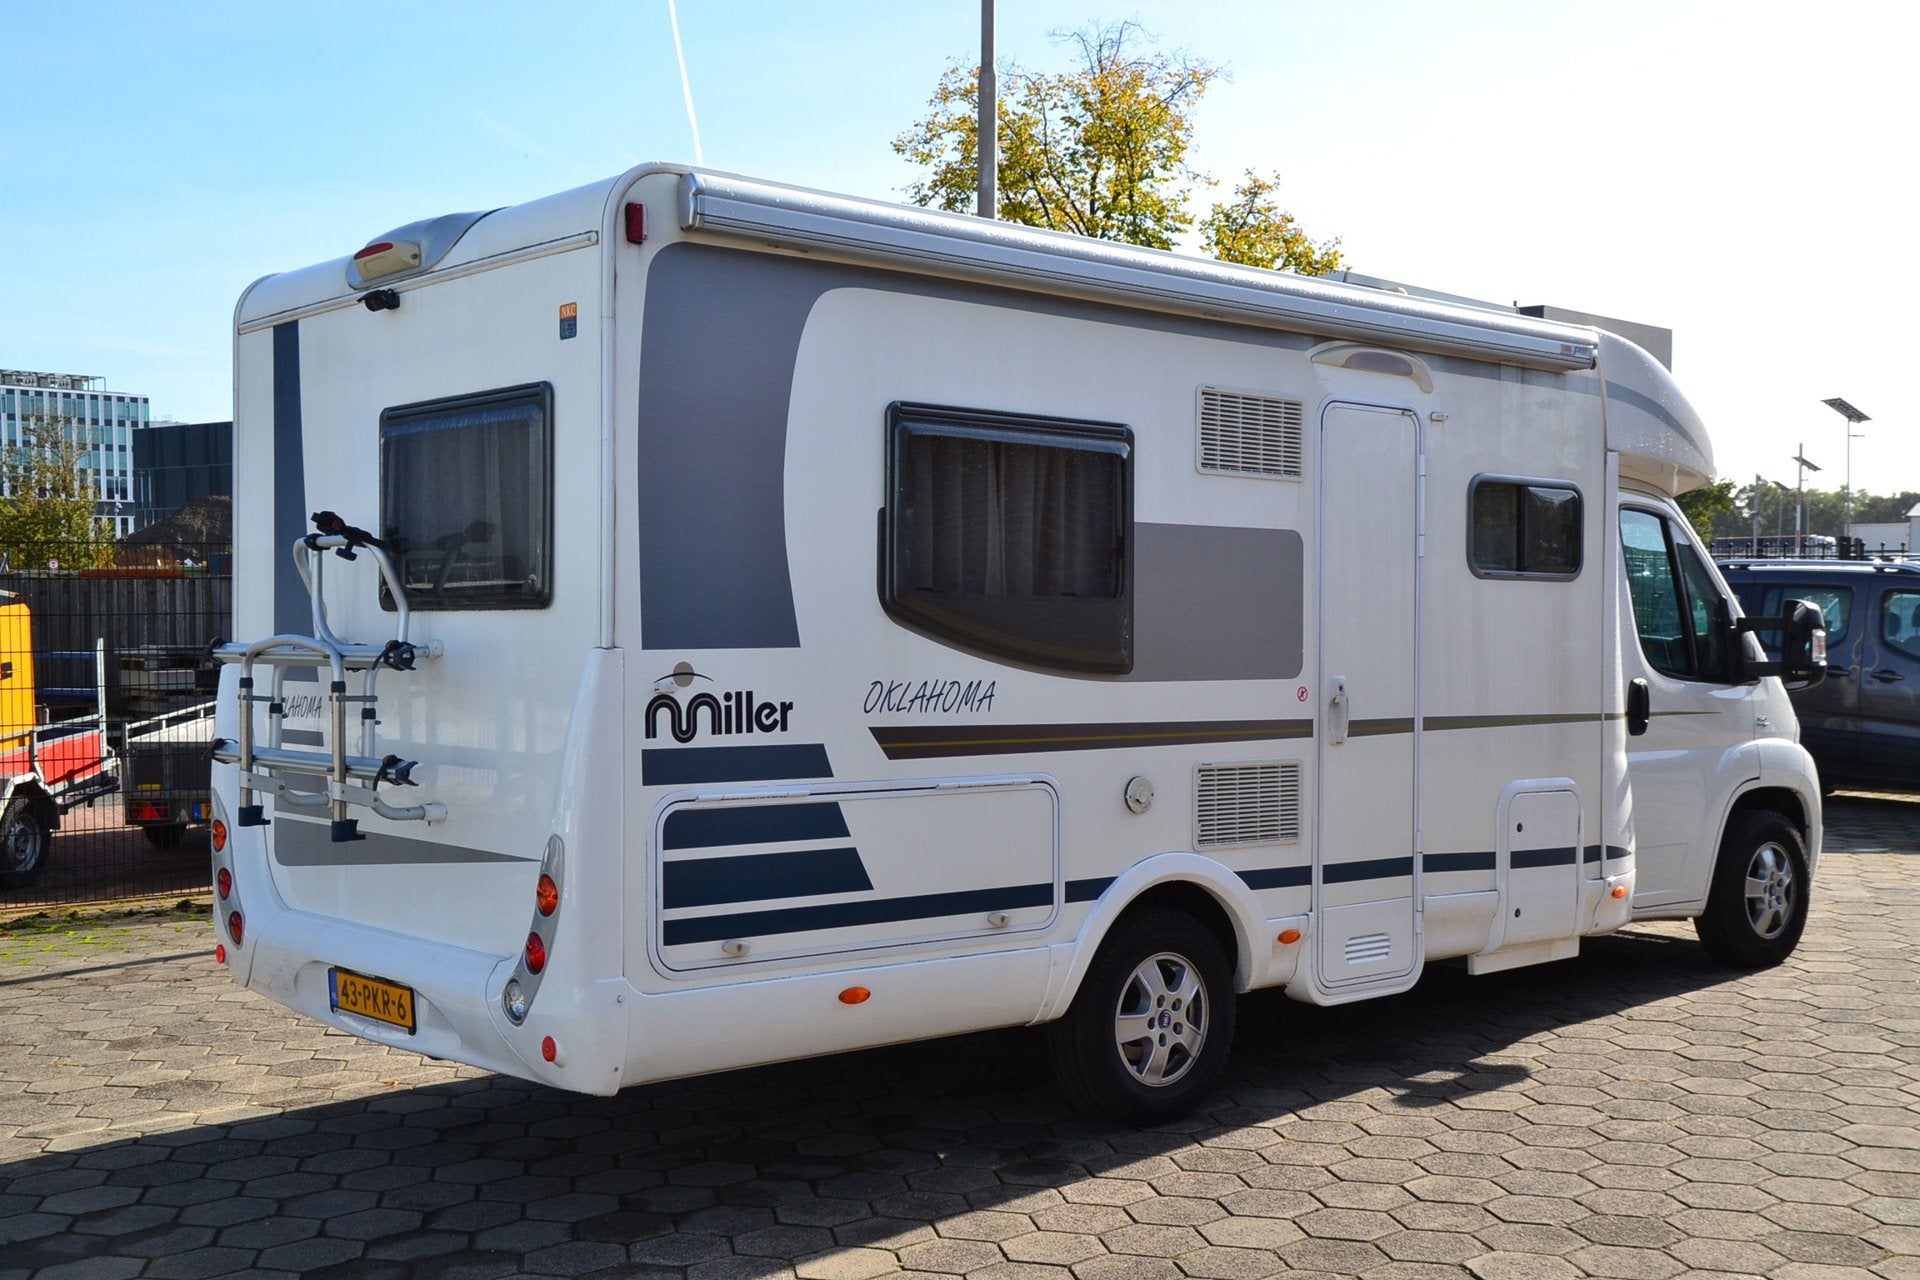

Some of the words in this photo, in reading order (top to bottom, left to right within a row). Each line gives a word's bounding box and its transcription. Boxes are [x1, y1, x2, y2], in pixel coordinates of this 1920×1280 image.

[282, 695, 322, 719] LAHOMA
[863, 679, 996, 714] OKLAHOMA
[645, 690, 794, 744] Miller
[341, 979, 407, 1021] 43-PKR-6
